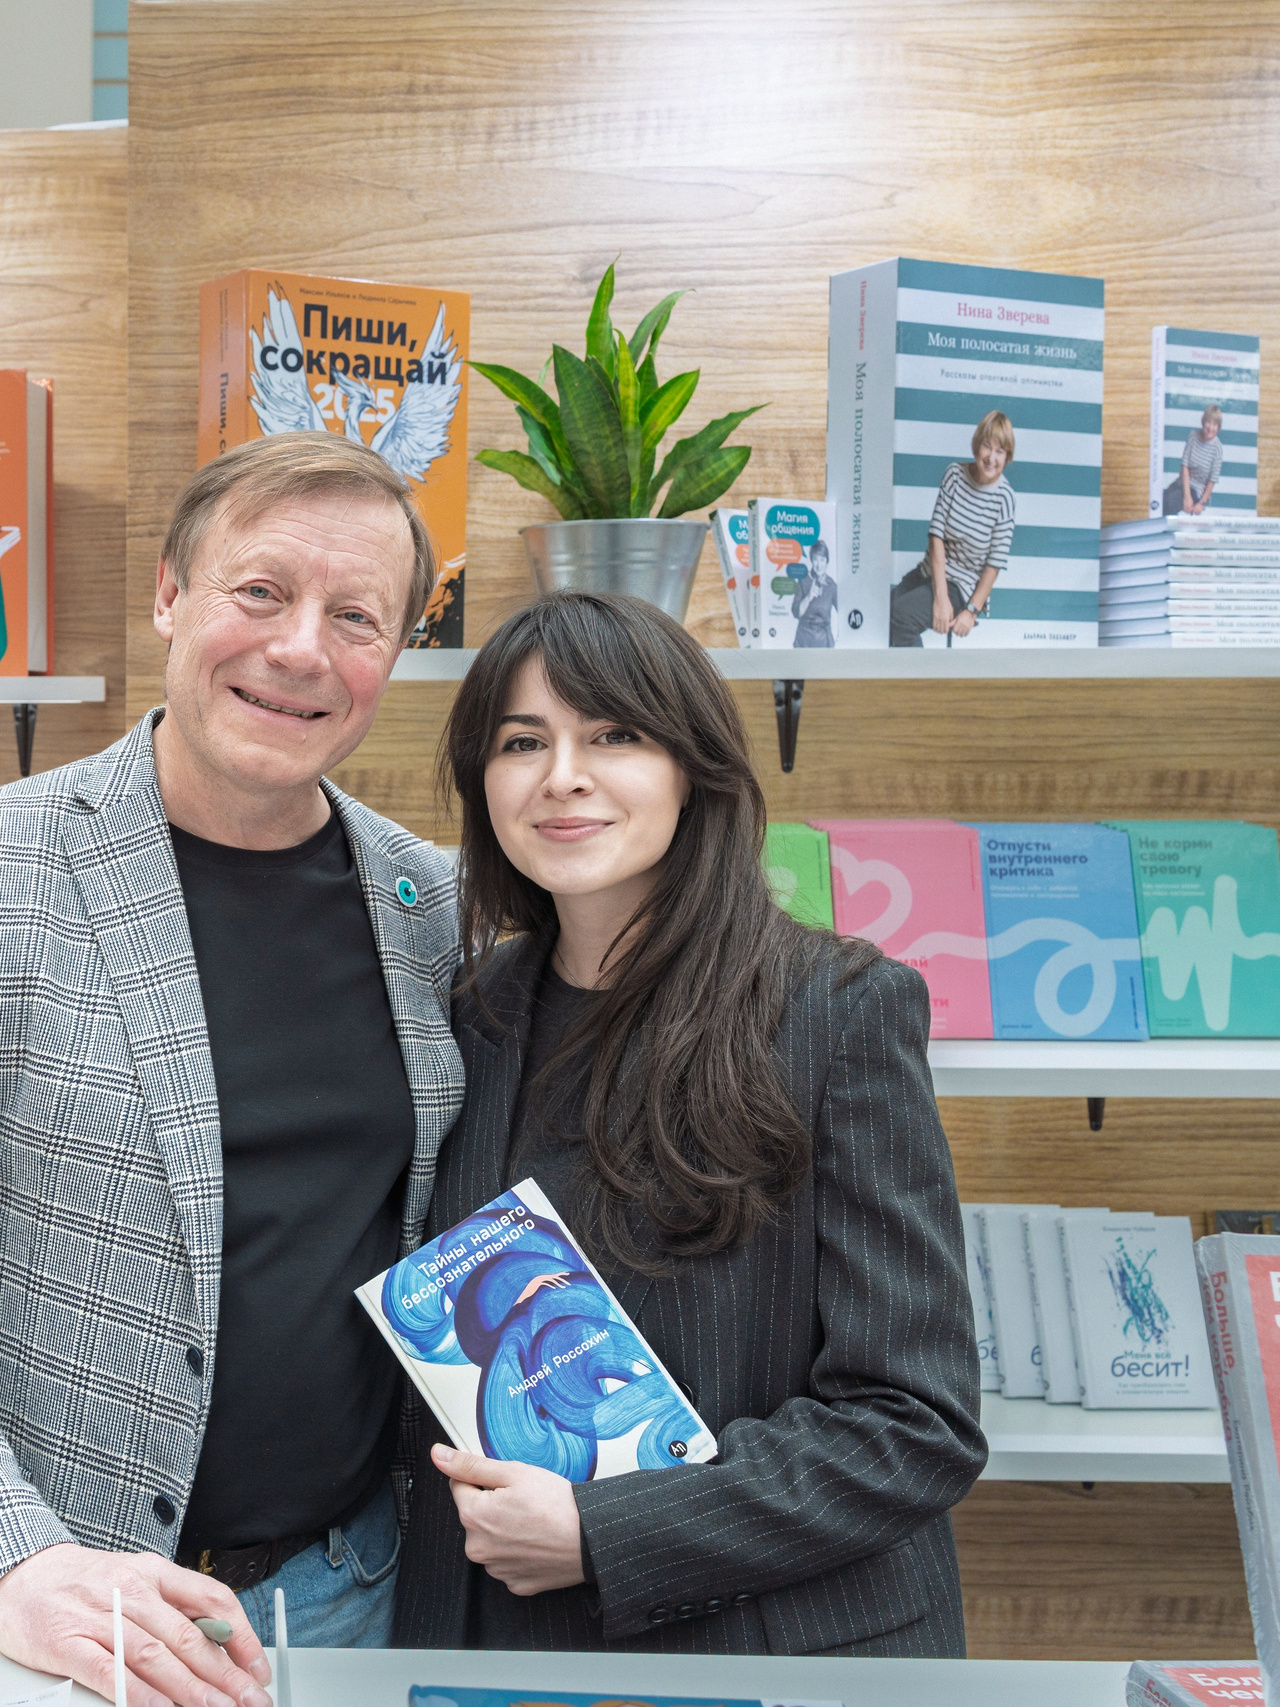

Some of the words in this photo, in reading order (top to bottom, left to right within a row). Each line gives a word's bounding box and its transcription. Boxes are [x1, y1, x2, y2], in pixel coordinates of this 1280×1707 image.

[303, 302, 417, 353] Пиши,
[956, 302, 993, 320] Нина
[997, 306, 1050, 326] Зверева
[927, 331, 957, 349] Моя
[960, 336, 1030, 355] полосатая
[1034, 342, 1078, 360] жизнь
[260, 344, 448, 388] сокращай
[854, 361, 867, 402] Моя
[852, 407, 865, 506] полосатая
[770, 522, 815, 536] общения
[776, 510, 809, 524] Магия
[850, 512, 862, 575] жизнь
[986, 838, 1052, 854] Отпусти
[1138, 837, 1159, 849] Не
[1163, 840, 1213, 852] корми
[1140, 852, 1180, 862] свою
[988, 853, 1089, 867] внутреннего
[989, 865, 1055, 880] критика
[1141, 865, 1202, 878] тревогу
[417, 1238, 468, 1279] Тайны
[470, 1203, 527, 1250] нашего
[400, 1216, 536, 1311] бессознательного
[1210, 1270, 1236, 1377] Больше,
[507, 1362, 553, 1399] Андрей
[551, 1328, 611, 1369] Россохин
[1110, 1354, 1190, 1378] бесит!
[1201, 1275, 1215, 1325] чем
[1210, 1333, 1233, 1442] коробка
